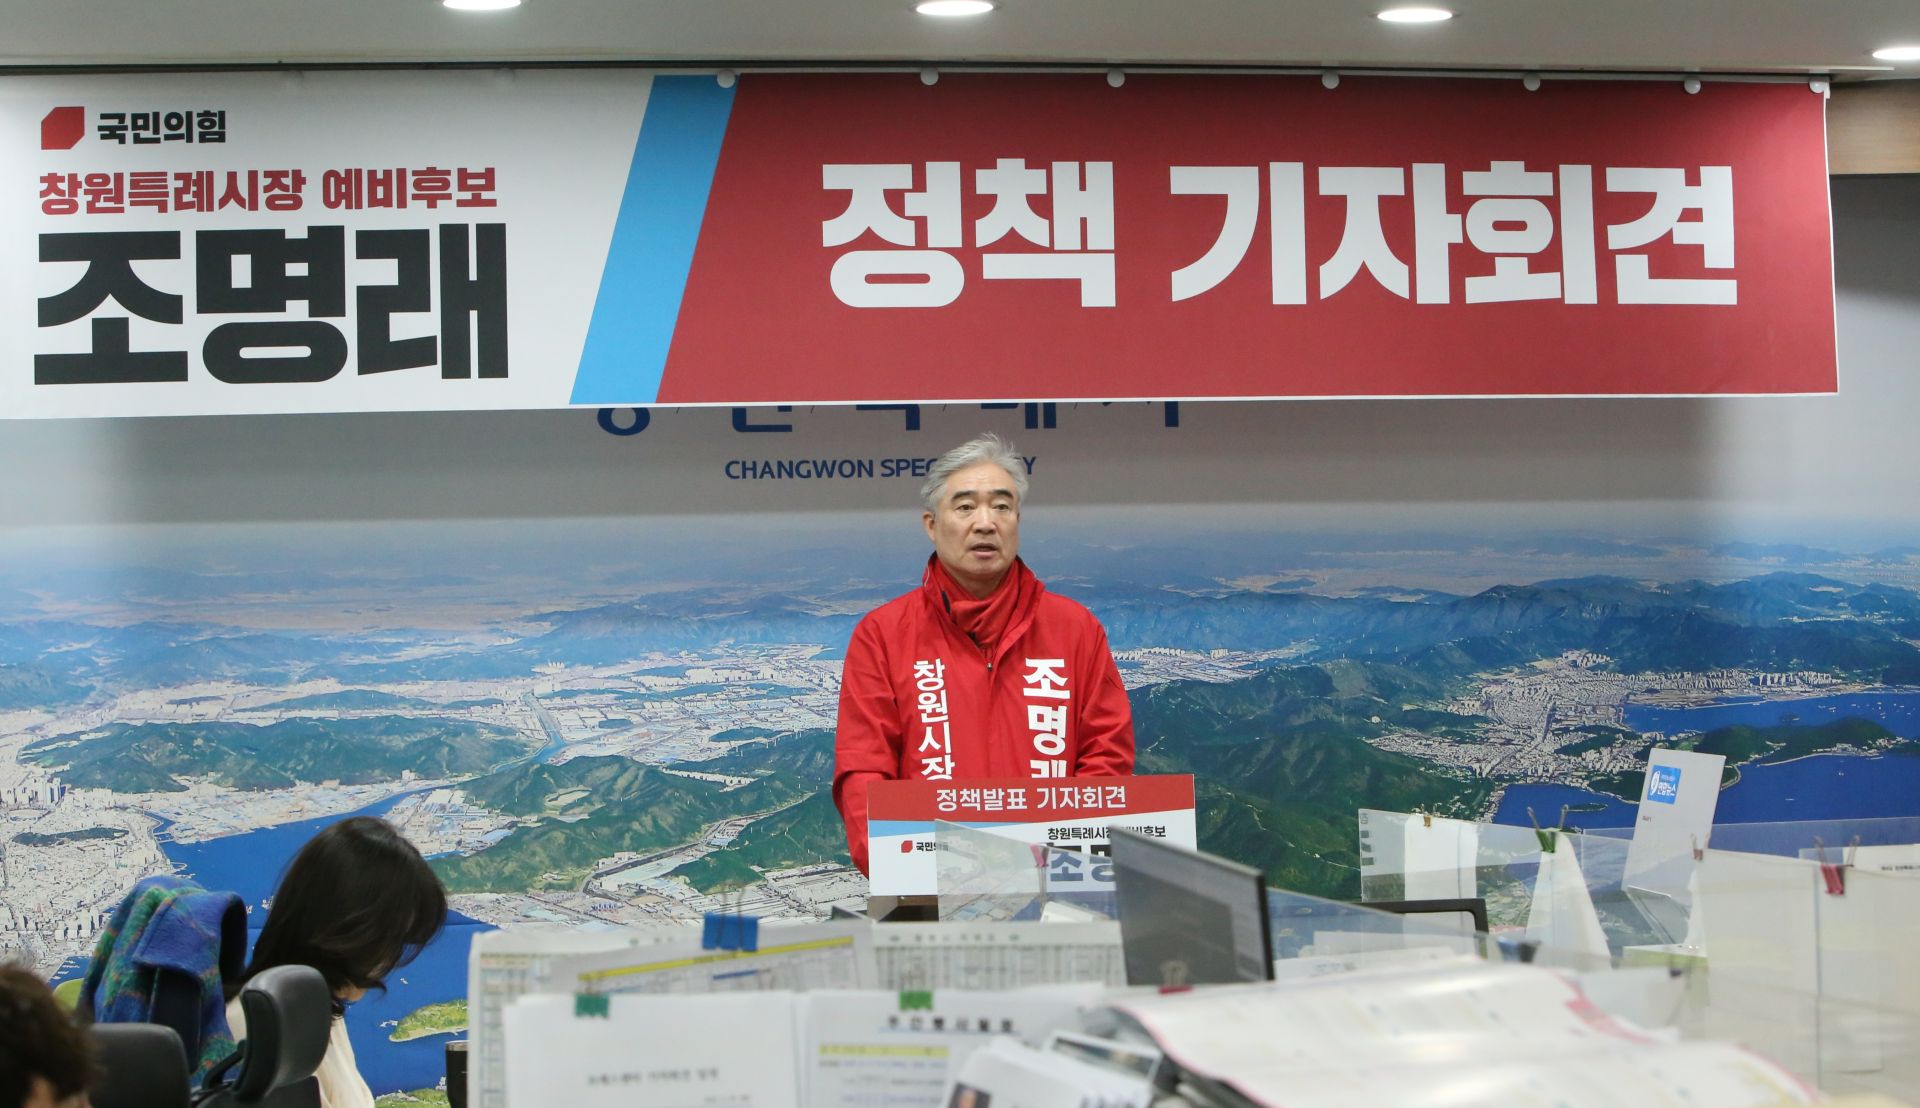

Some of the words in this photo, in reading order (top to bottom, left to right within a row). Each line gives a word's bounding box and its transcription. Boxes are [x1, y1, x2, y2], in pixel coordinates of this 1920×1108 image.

[97, 109, 227, 145] 국민의힘
[39, 169, 306, 216] 창원특례시장
[322, 166, 497, 210] 예비후보
[822, 158, 1116, 308] 정책
[1169, 160, 1738, 306] 기자회견
[33, 222, 509, 386] 조명래
[724, 458, 874, 480] CHANGWON
[912, 657, 956, 780] 창원시장
[936, 787, 1028, 813] 정책발표
[1036, 785, 1127, 810] 기자회견
